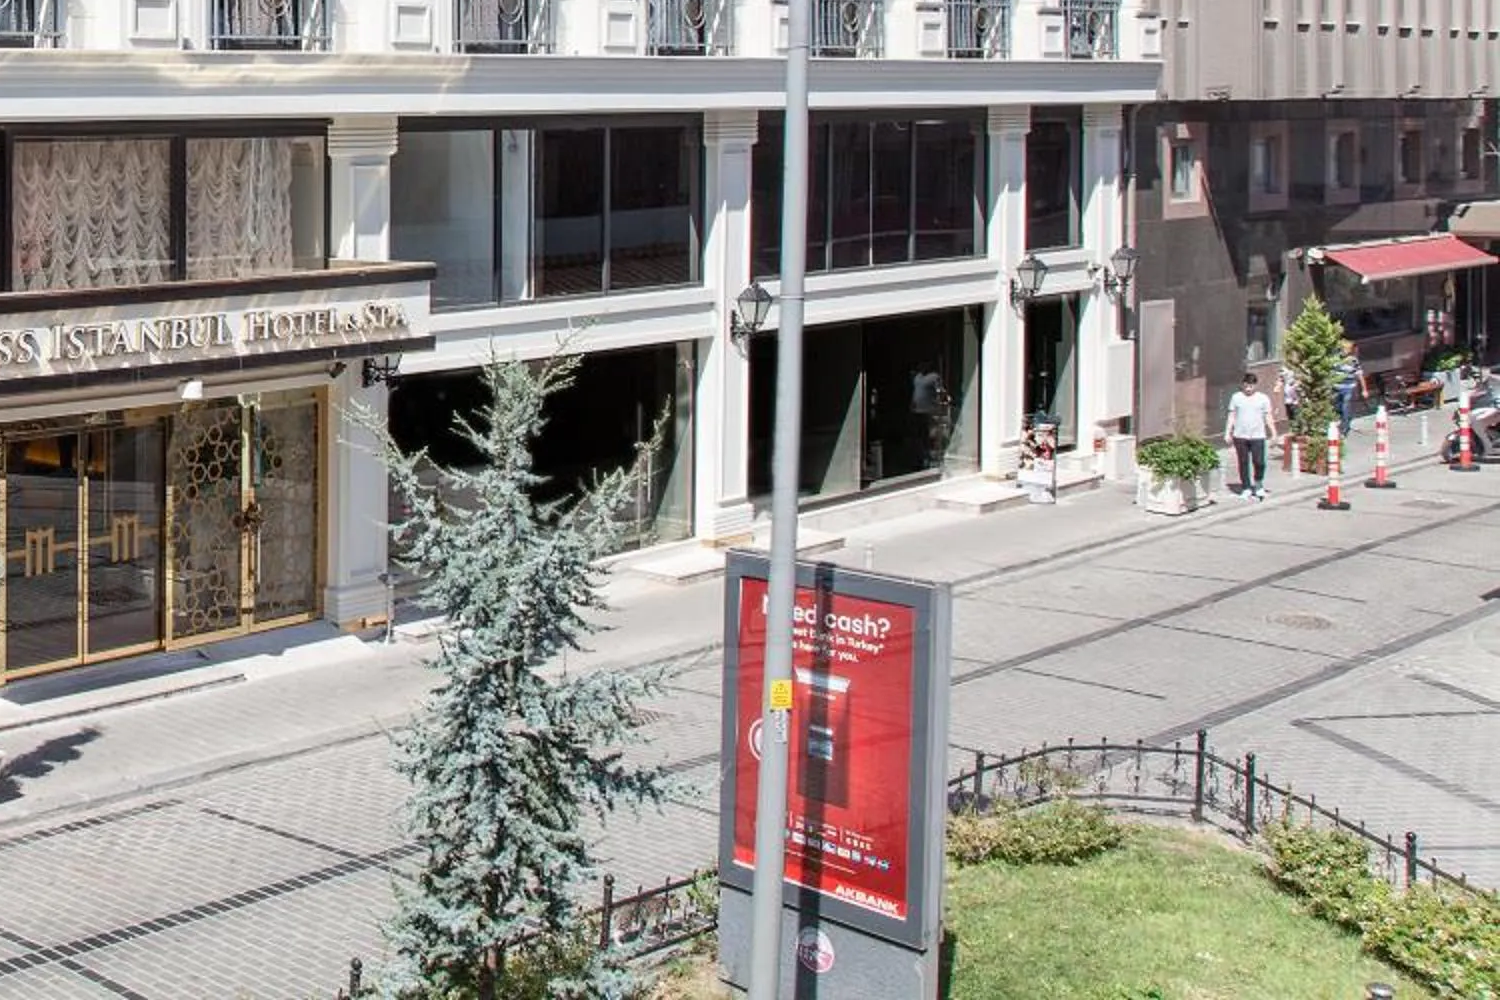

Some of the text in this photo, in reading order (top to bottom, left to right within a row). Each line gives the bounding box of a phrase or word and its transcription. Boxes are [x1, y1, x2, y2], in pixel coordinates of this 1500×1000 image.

[50, 314, 230, 361] ISTANBUL
[244, 307, 338, 341] HOTEL
[363, 301, 408, 328] SPA
[825, 613, 891, 639] cash?
[835, 884, 900, 916] AKBANK
